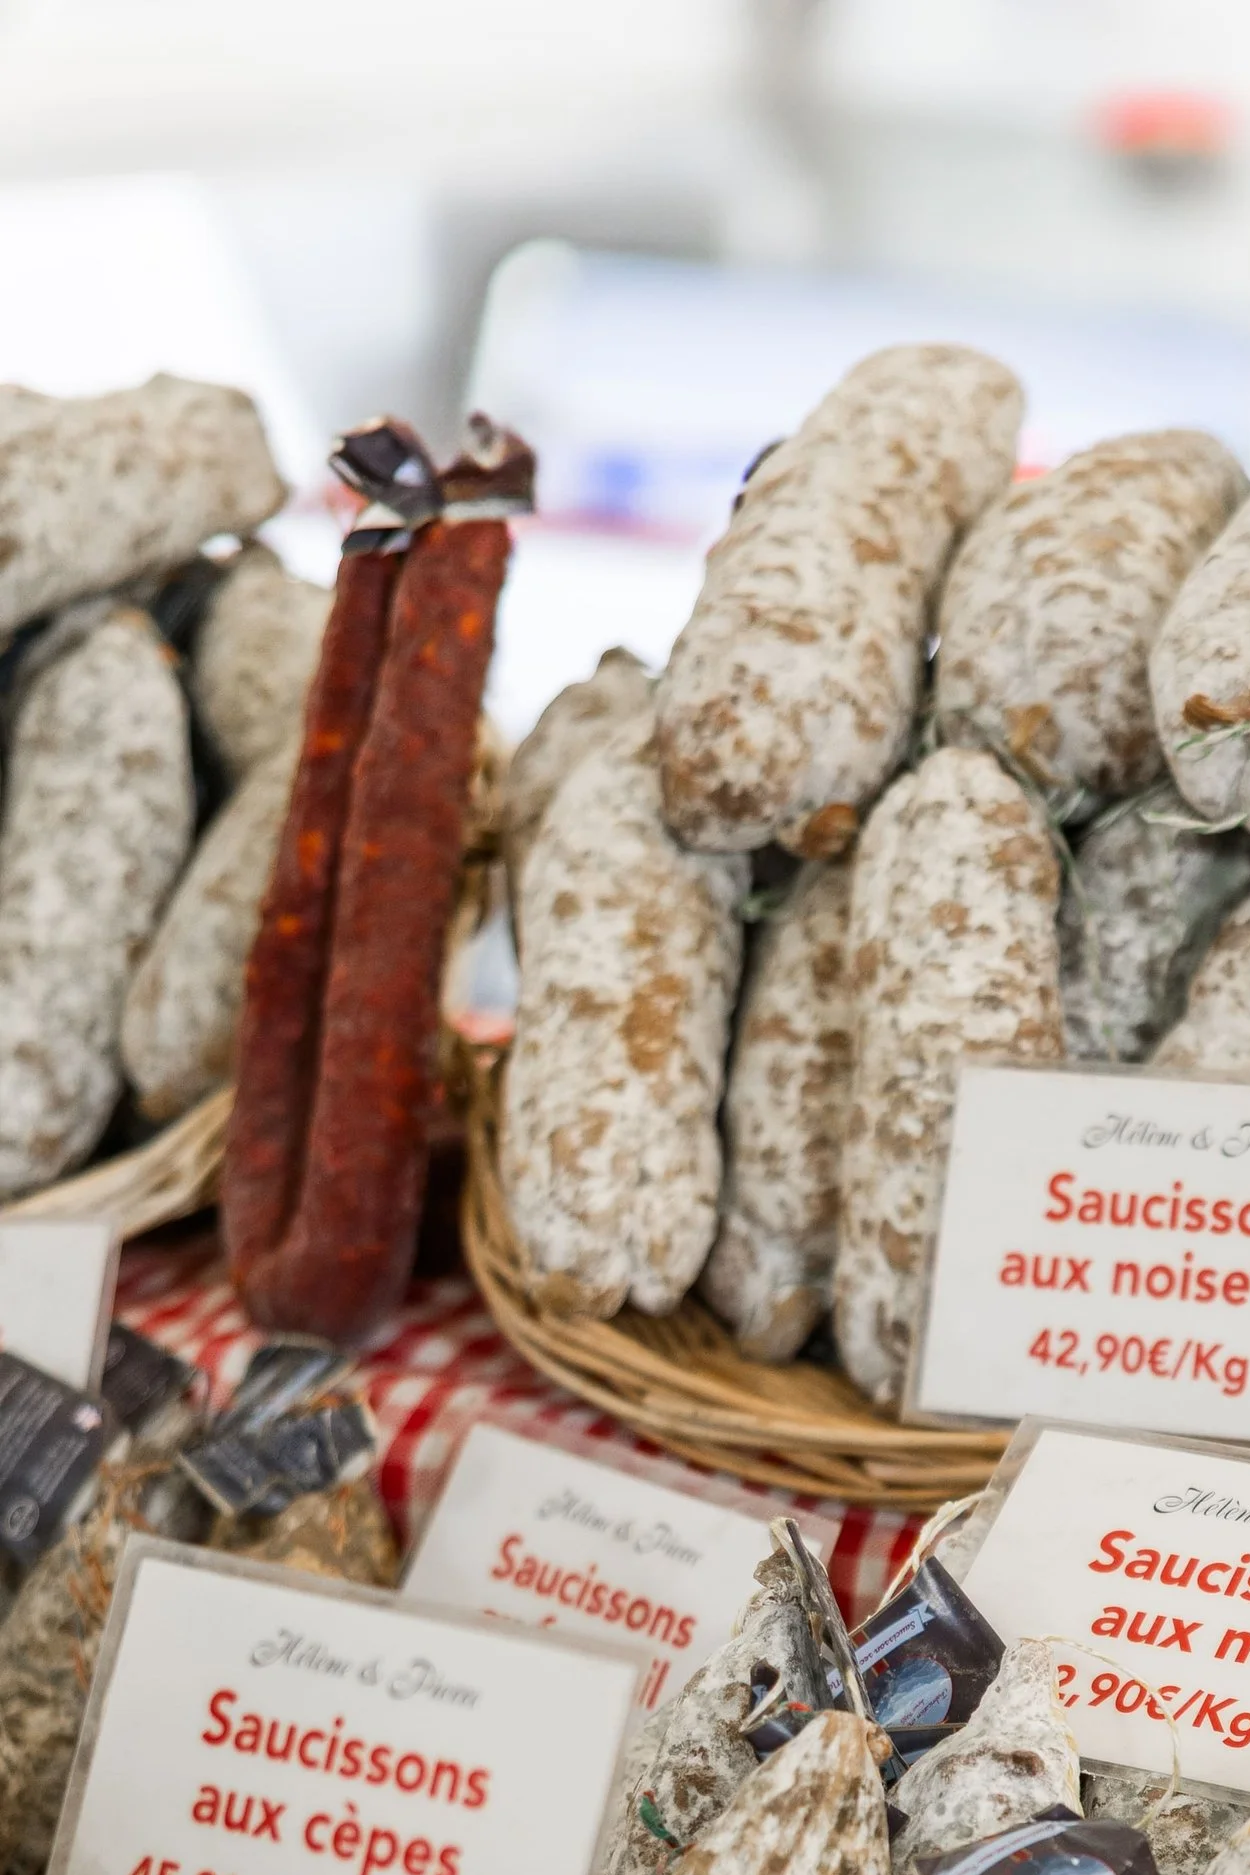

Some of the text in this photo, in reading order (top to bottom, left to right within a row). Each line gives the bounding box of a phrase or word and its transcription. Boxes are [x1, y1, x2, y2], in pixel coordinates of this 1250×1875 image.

[1081, 1113, 1182, 1150] Hélène
[1189, 1125, 1211, 1151] &
[999, 1250, 1092, 1292] aux
[1028, 1328, 1250, 1398] 42,90€/Kg
[490, 1534, 697, 1650] Saucissons
[1091, 1606, 1203, 1653] aux
[200, 1688, 490, 1810] Saucissons
[190, 1783, 287, 1844] aux
